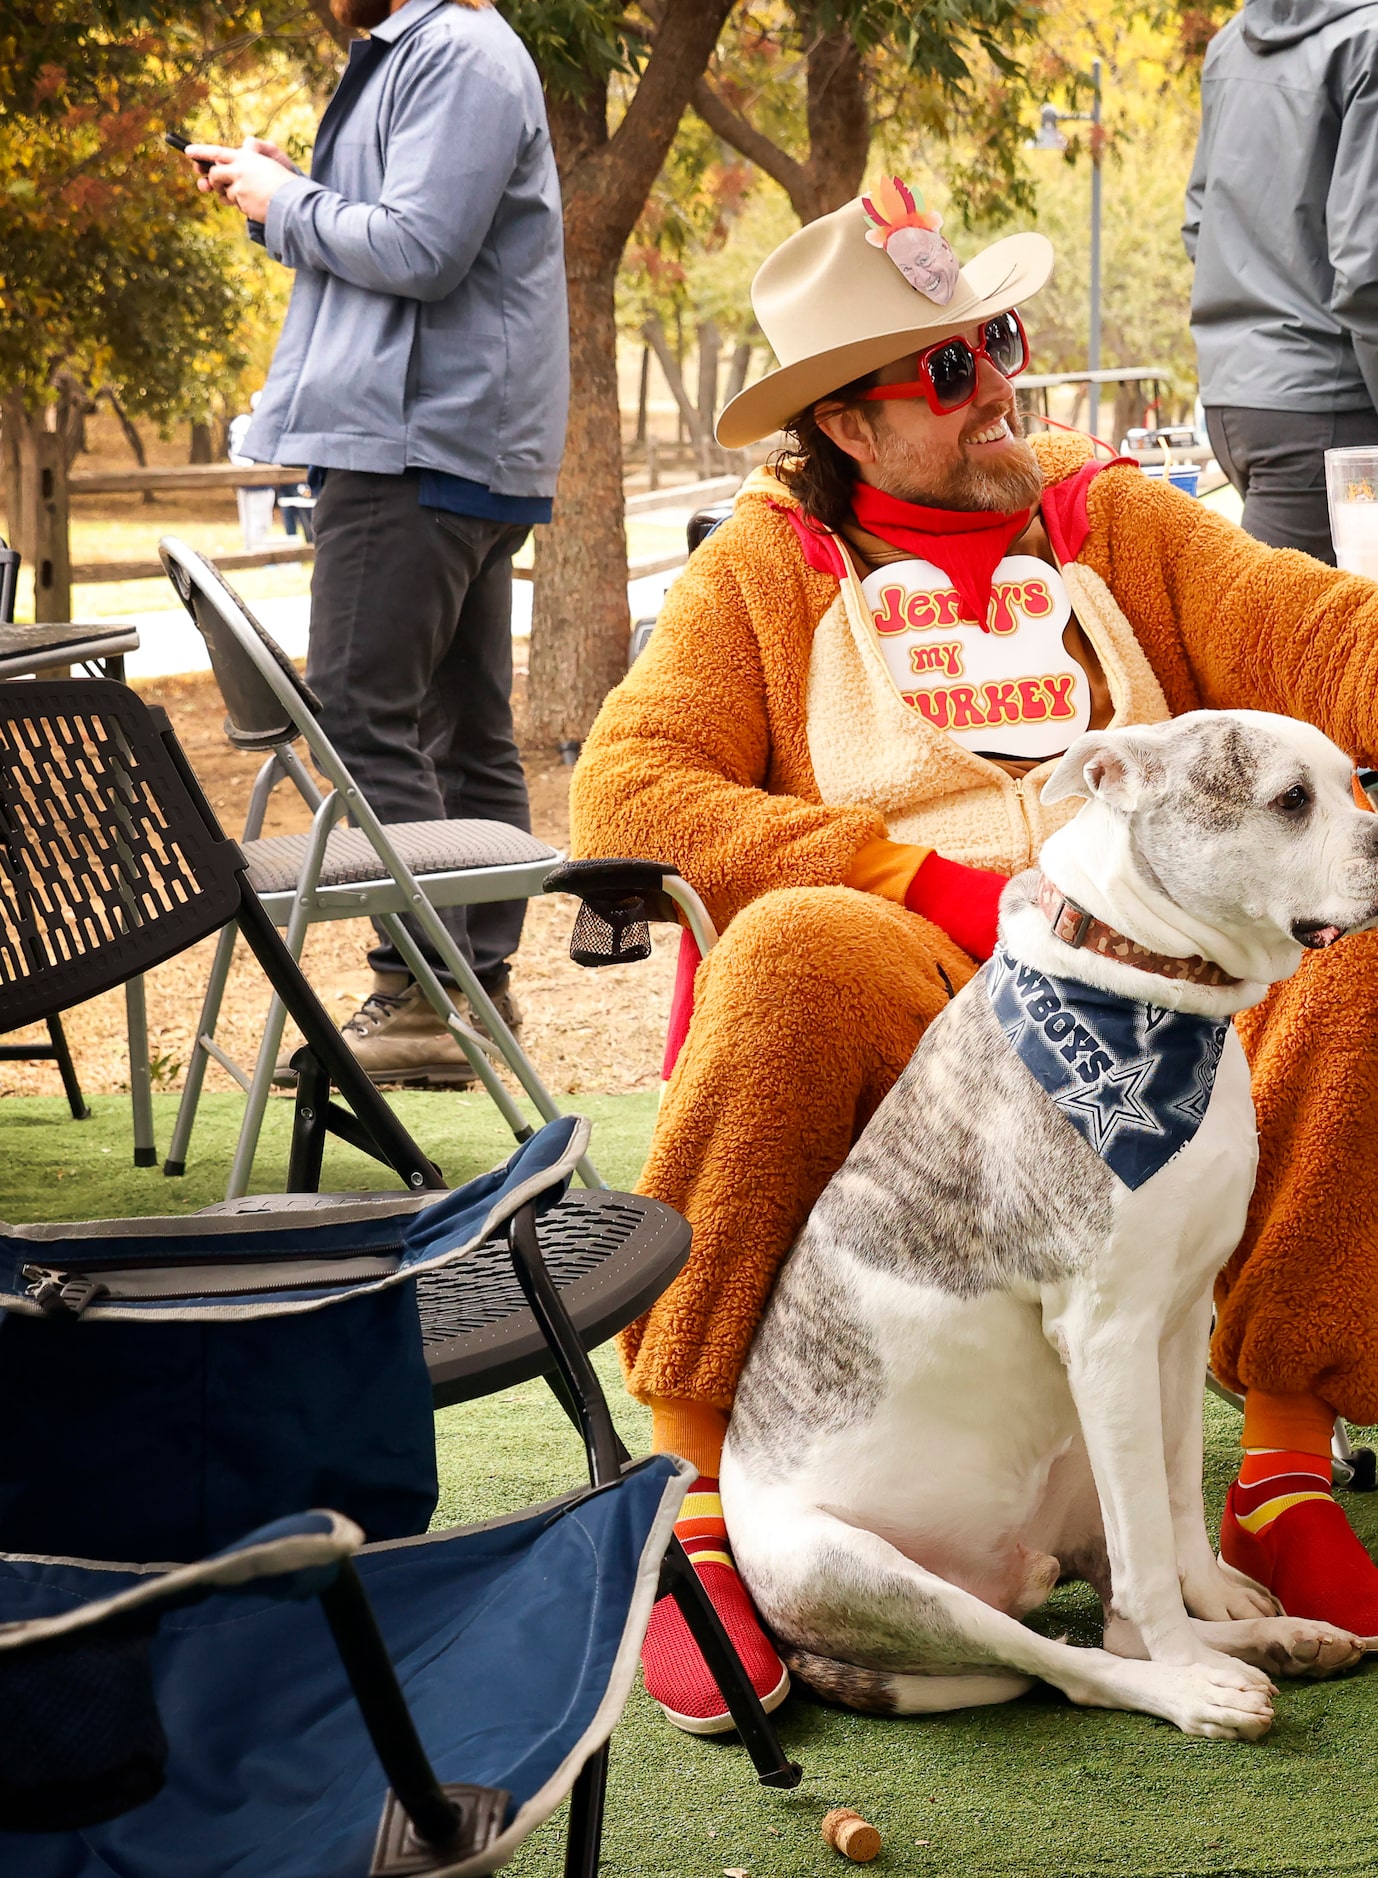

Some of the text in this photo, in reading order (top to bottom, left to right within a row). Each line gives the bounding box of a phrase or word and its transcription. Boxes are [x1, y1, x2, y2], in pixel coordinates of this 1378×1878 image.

[873, 581, 1052, 635] Jery's
[909, 641, 962, 677] my
[901, 675, 1075, 730] URKEY
[1003, 952, 1114, 1083] WBOYS
